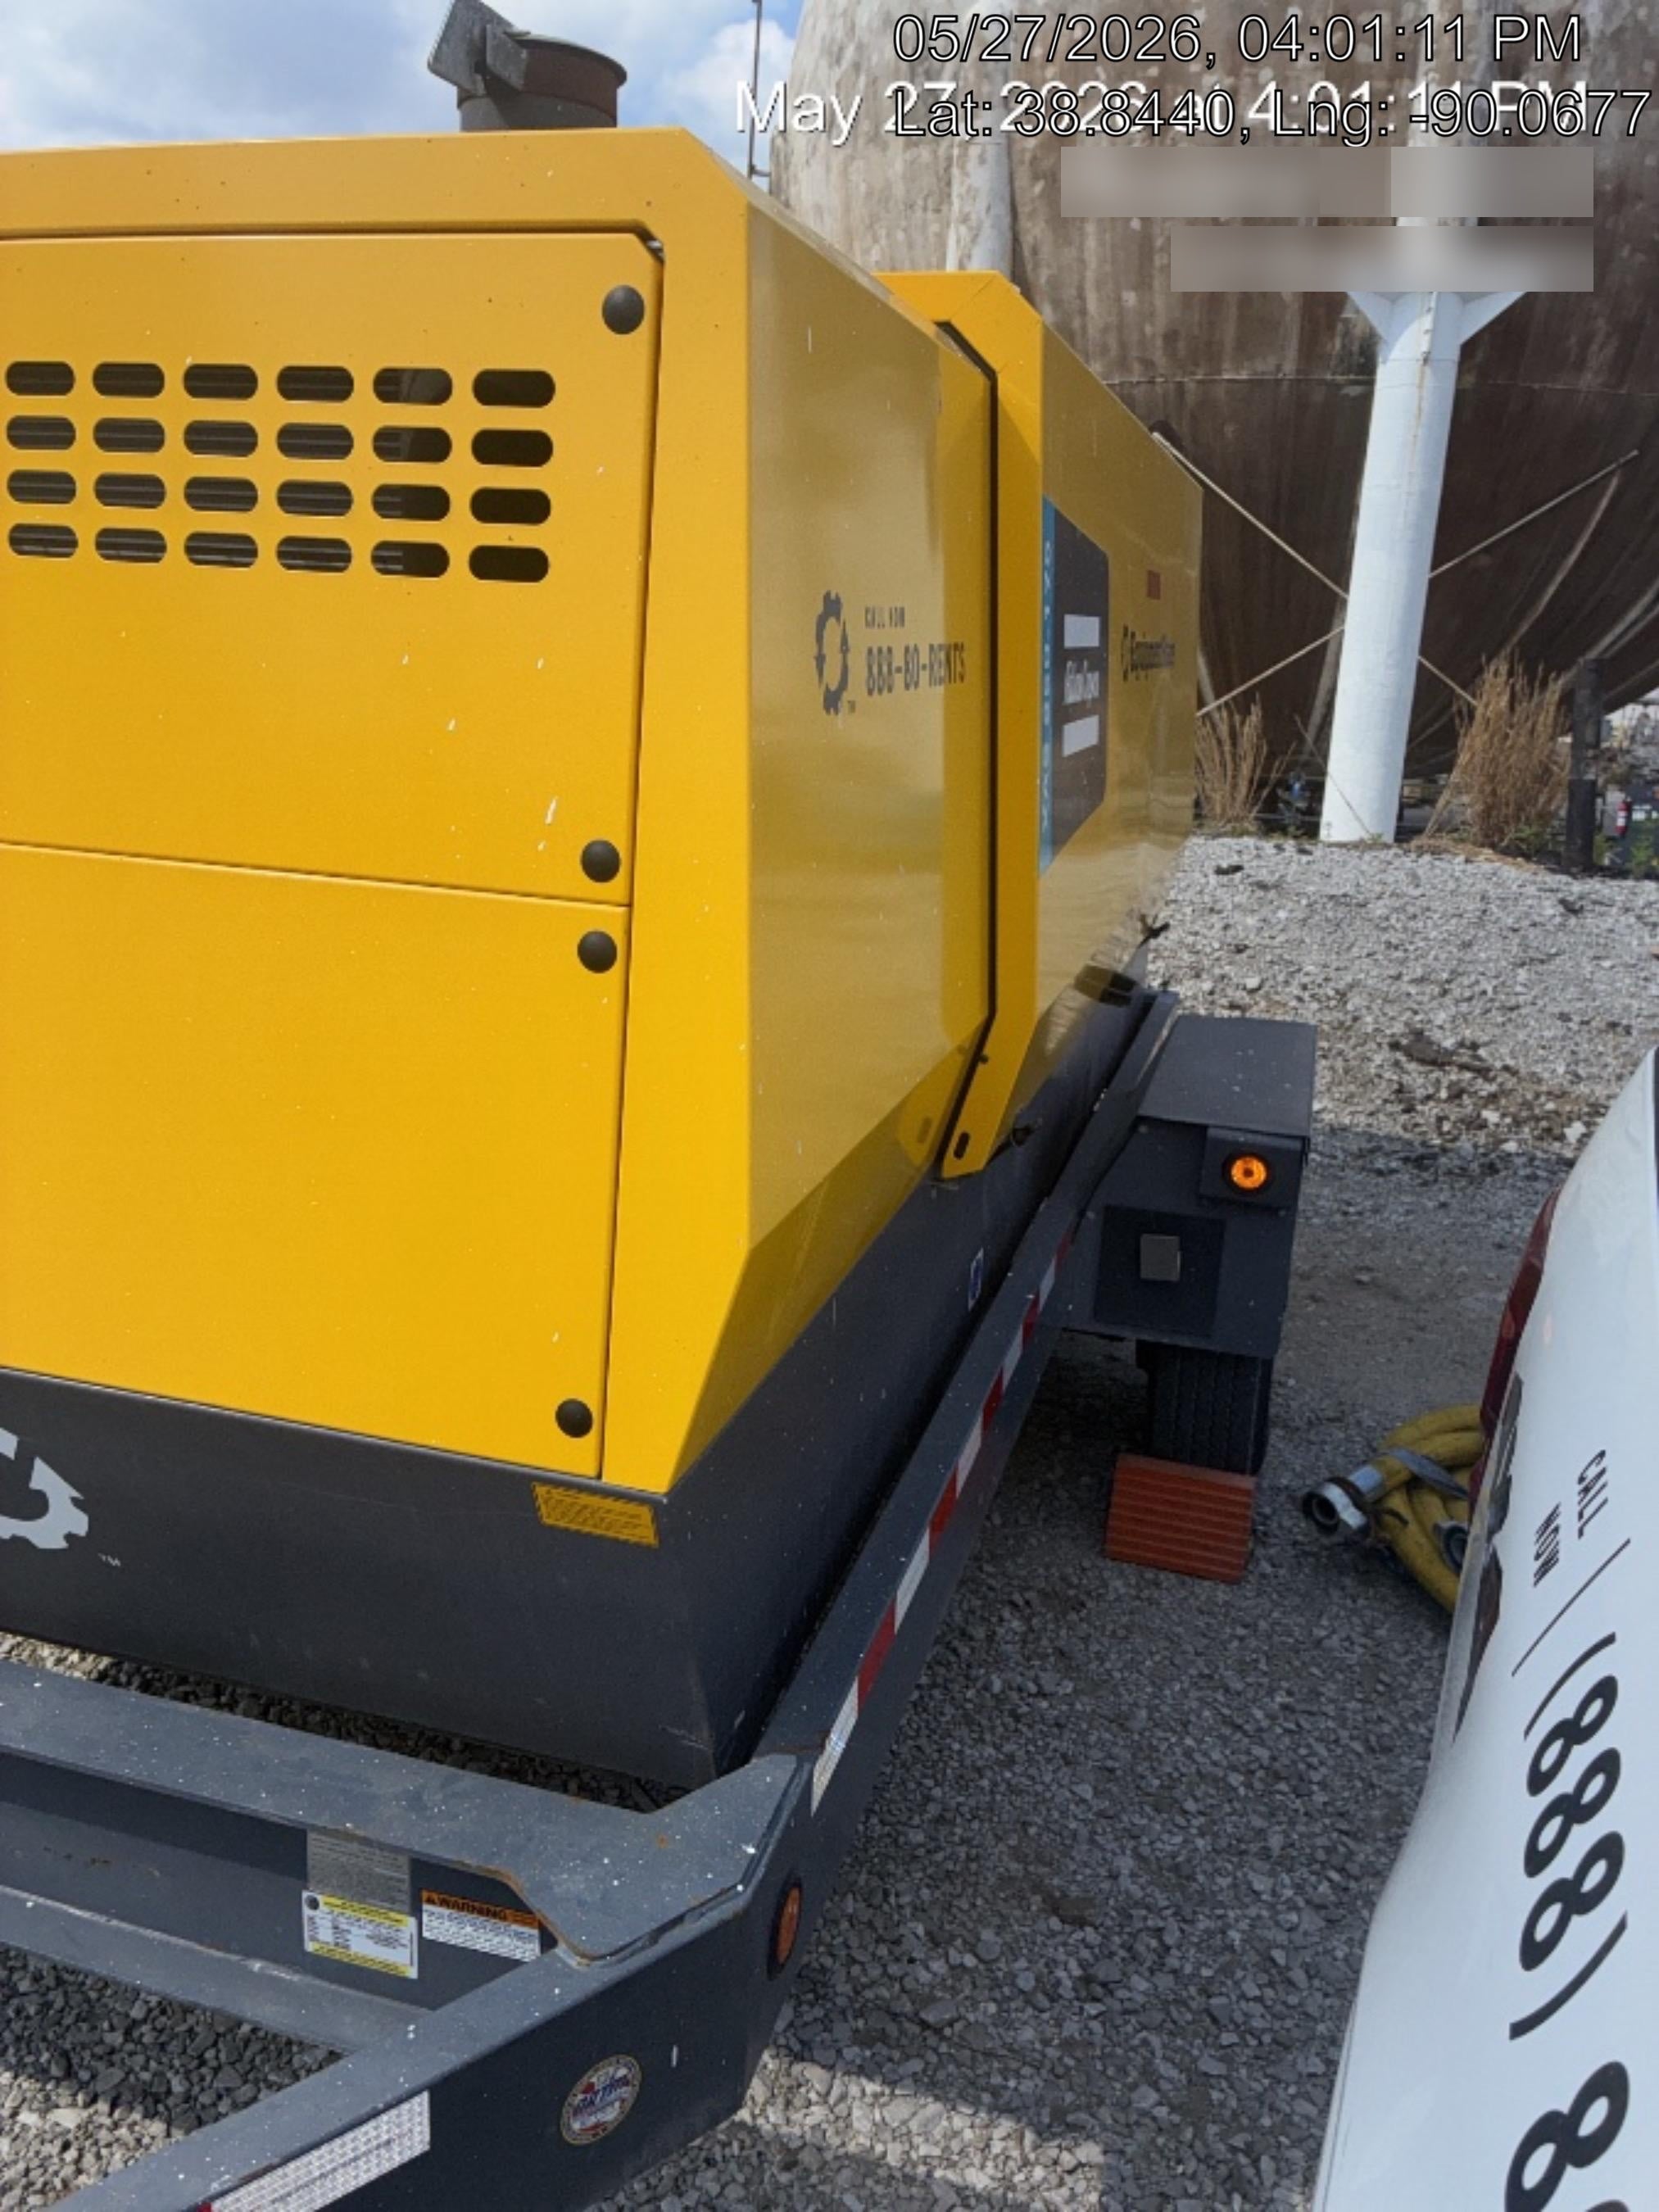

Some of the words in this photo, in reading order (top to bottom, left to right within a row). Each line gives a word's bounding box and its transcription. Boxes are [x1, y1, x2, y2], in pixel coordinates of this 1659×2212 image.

[1577, 1449, 1608, 1539] CALL
[1534, 1502, 1561, 1588] NOW
[1509, 1631, 1628, 2041] (888)
[437, 1894, 508, 1920] WARNING
[1504, 2060, 1630, 2212] 8
